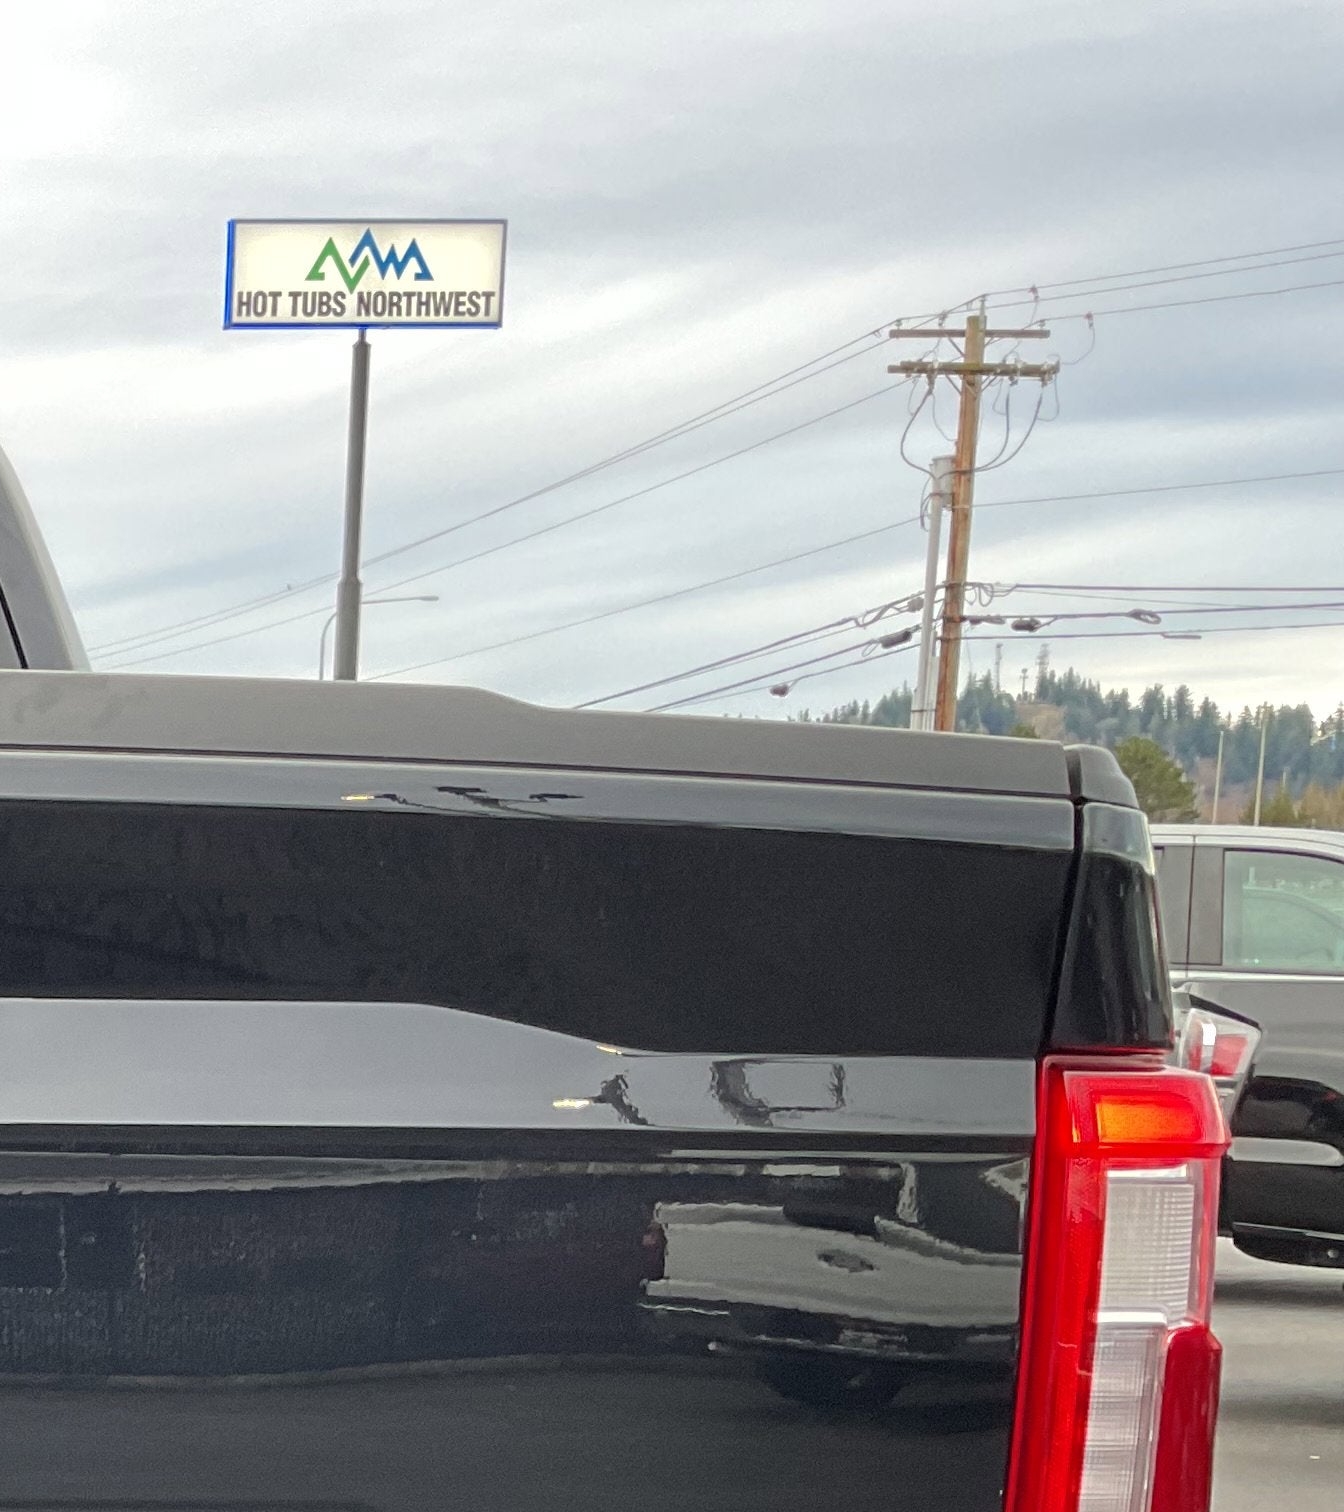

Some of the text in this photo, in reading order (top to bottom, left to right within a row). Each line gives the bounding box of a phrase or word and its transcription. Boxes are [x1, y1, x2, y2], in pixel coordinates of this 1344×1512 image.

[237, 291, 495, 318] HOT TUBS NORTHWEST
